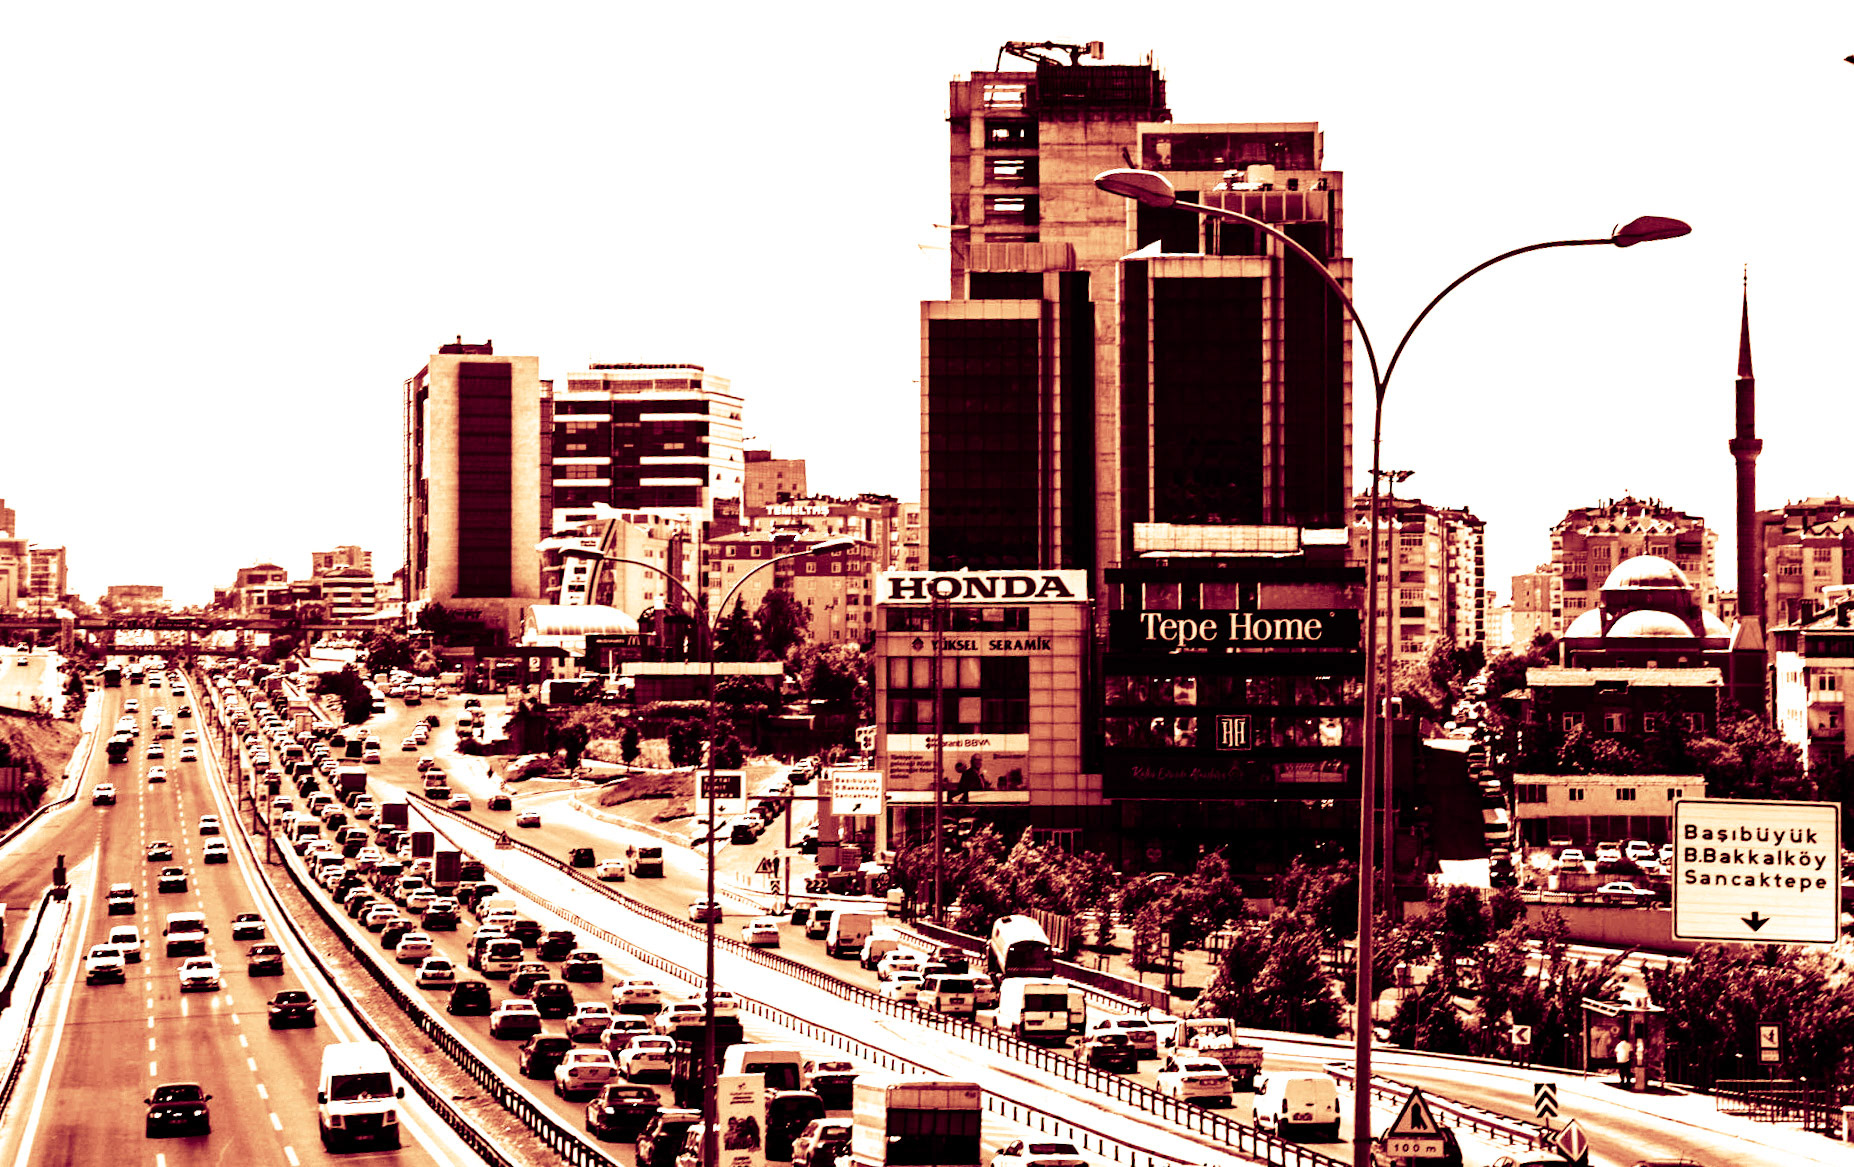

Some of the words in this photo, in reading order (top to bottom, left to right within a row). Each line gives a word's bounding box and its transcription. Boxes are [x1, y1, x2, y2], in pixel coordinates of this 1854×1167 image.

[888, 576, 1075, 600] HONDA
[1140, 612, 1218, 647] Tepe
[1228, 612, 1323, 641] Home
[988, 636, 1052, 651] SERAMİK
[964, 738, 991, 748] BBVA
[1684, 824, 1817, 846] Başıbüyük
[1684, 847, 1827, 871] B.Bakkalköy
[1684, 869, 1827, 893] Sancaktepe
[1394, 1143, 1420, 1152] 100
